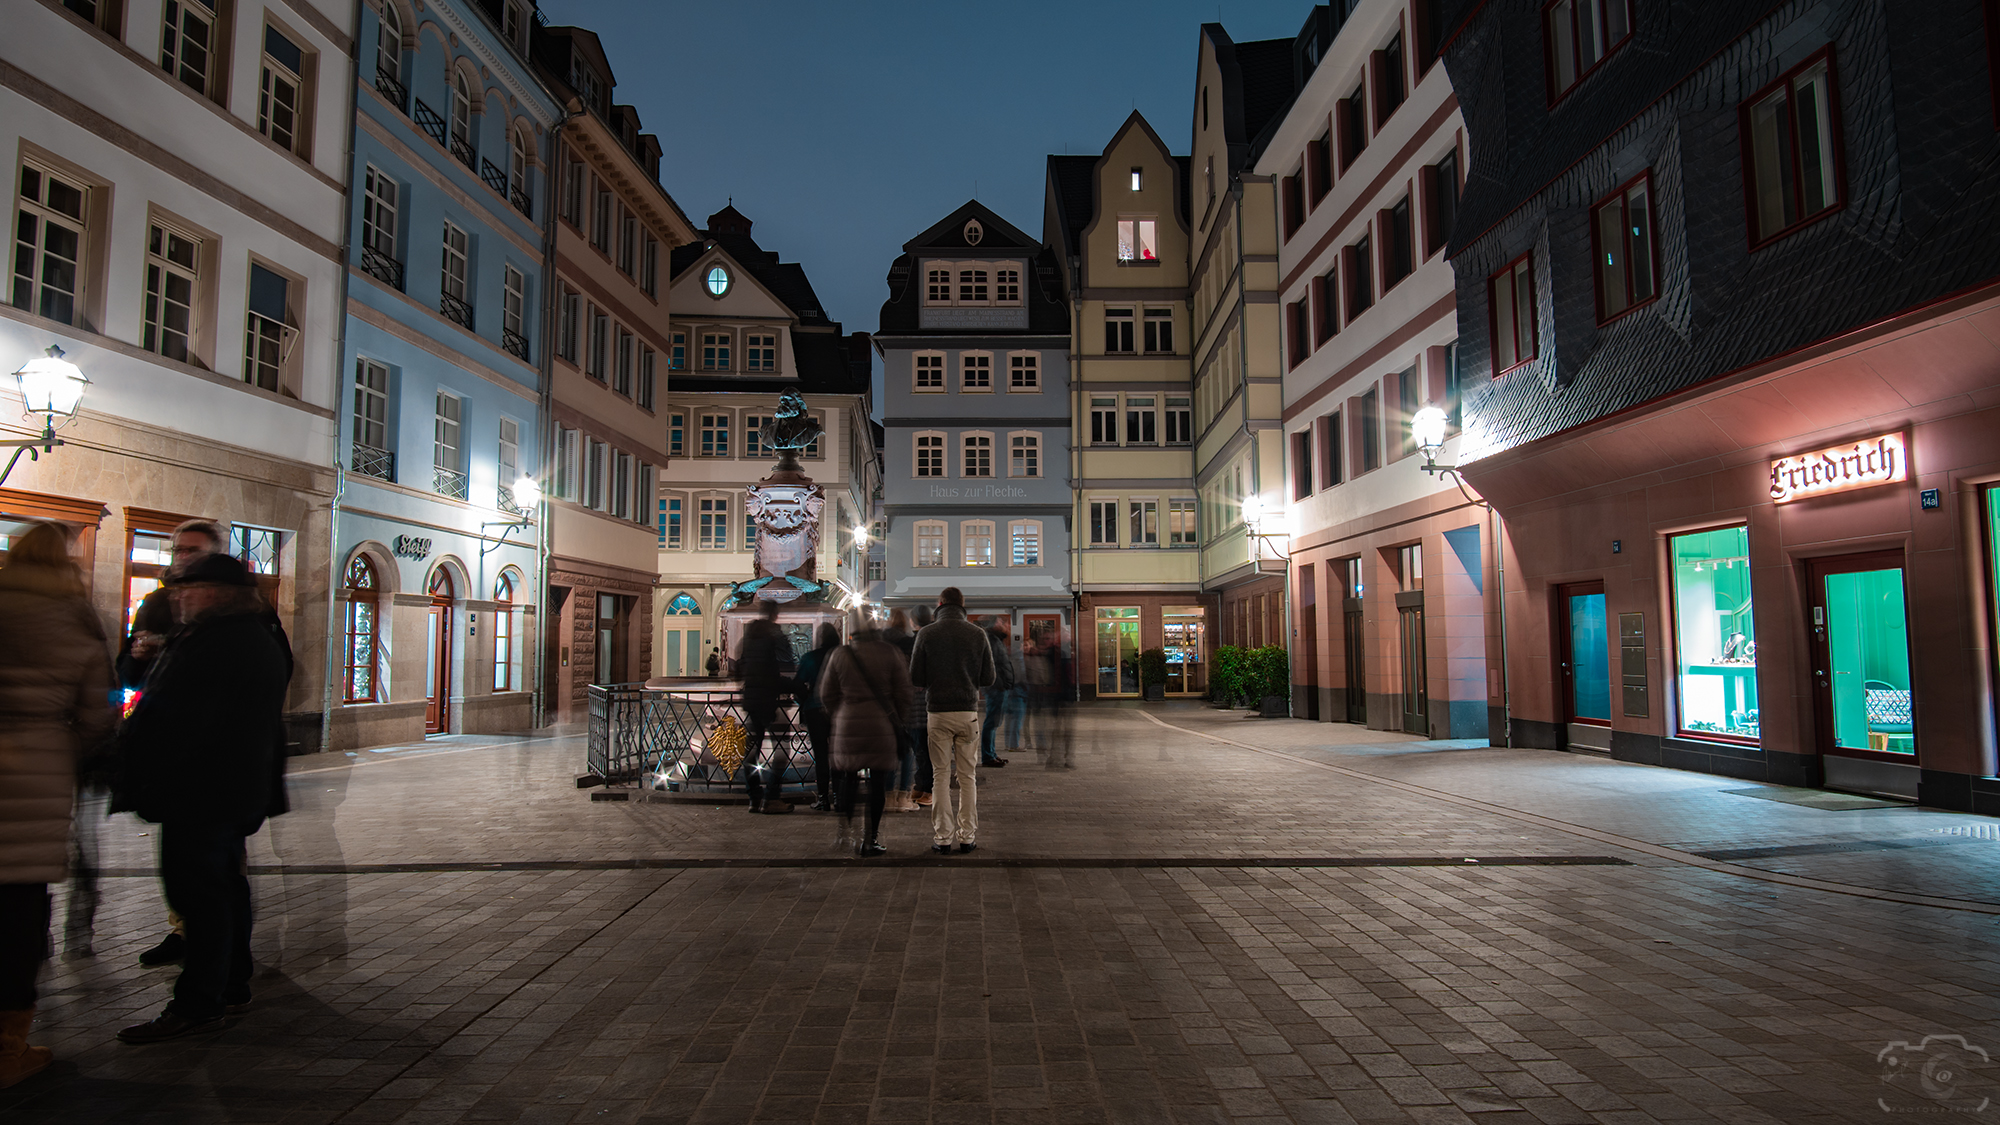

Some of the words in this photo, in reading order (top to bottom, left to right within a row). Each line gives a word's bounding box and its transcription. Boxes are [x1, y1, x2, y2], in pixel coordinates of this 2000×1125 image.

[1770, 438, 1896, 500] Friedrich
[930, 484, 959, 498] Haus
[964, 487, 983, 498] zur
[985, 484, 1027, 498] Flechte.
[1922, 497, 1936, 507] 14a
[397, 534, 432, 558] Steiff
